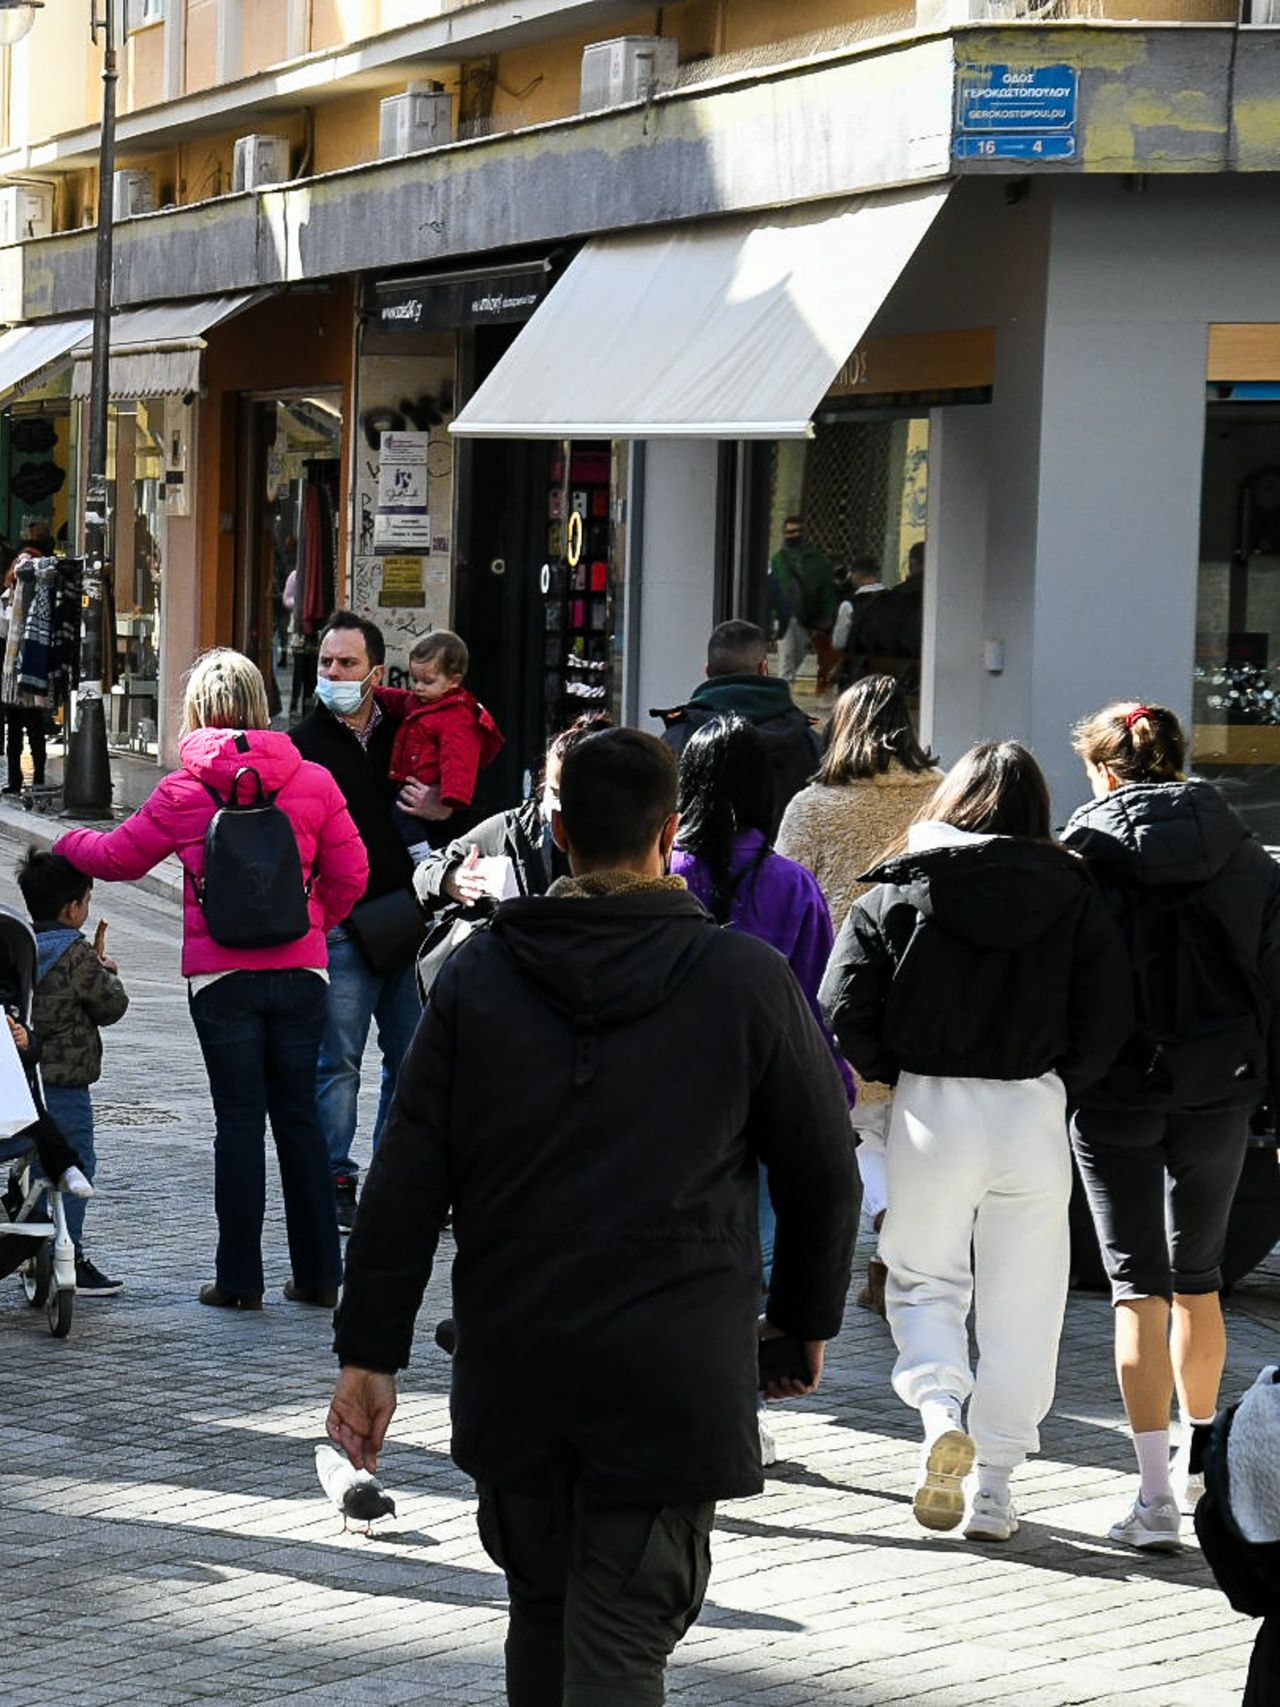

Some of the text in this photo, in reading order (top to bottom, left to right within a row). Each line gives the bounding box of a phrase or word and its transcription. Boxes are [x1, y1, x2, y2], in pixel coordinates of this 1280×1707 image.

[1002, 73, 1035, 84] ΟΔΟΣ
[963, 87, 1071, 99] ΓΕΡΟΚΩΣΤΟΠΟΥΛΟΥ
[968, 109, 1066, 120] GEROKOSTOPOULOU
[977, 140, 1043, 154] 16 4
